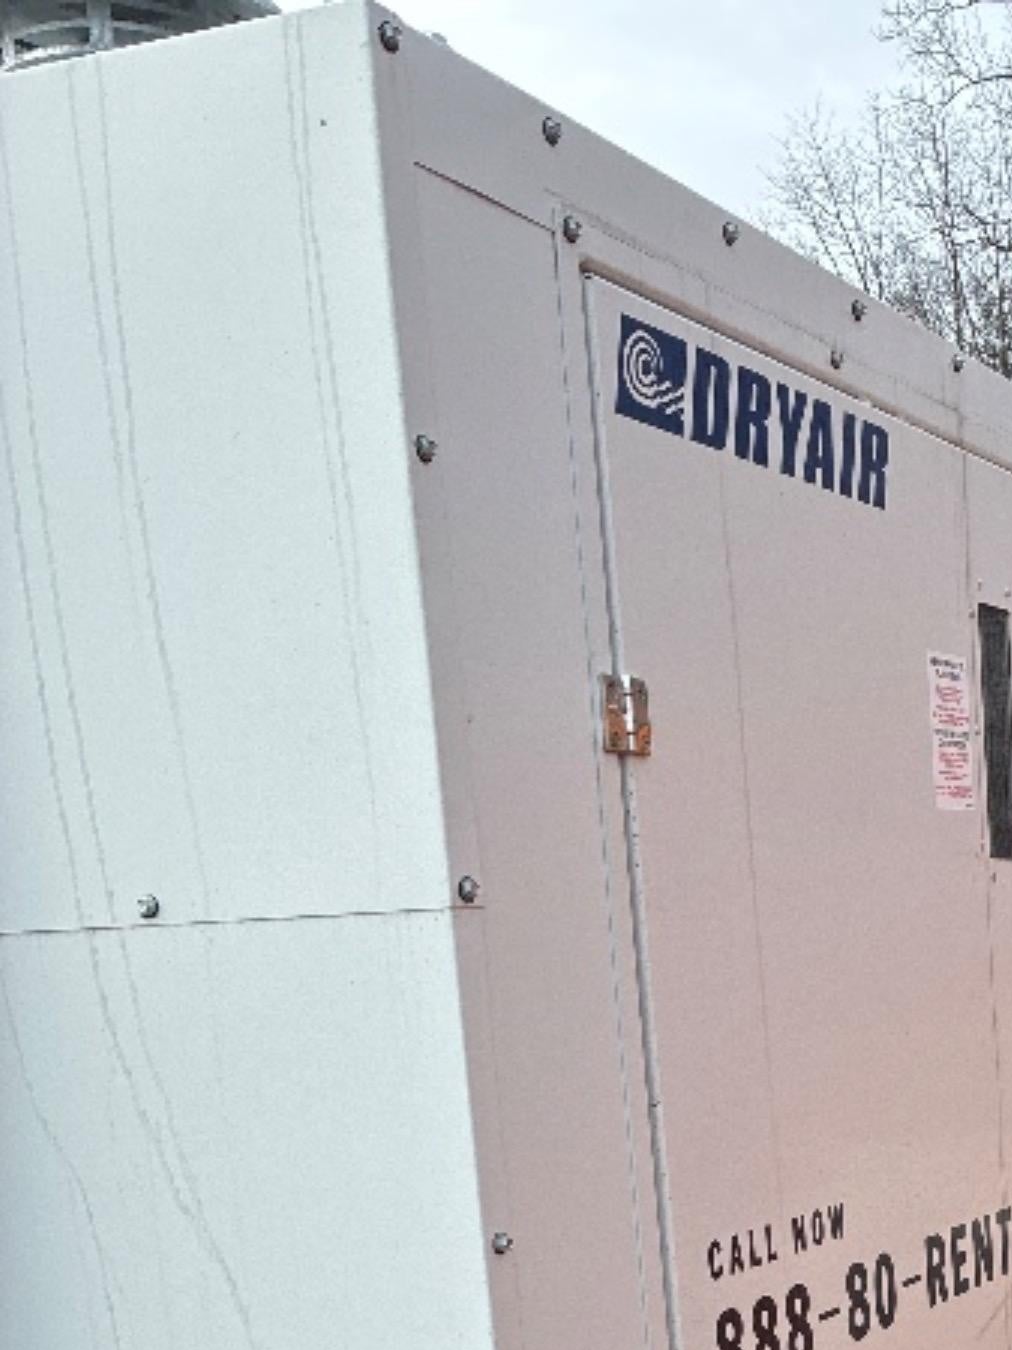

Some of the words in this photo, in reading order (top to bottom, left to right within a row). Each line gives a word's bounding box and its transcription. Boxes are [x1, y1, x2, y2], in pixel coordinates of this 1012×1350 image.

[689, 345, 890, 511] DRYAIR
[706, 1223, 779, 1281] CALL
[791, 1201, 845, 1255] NOW
